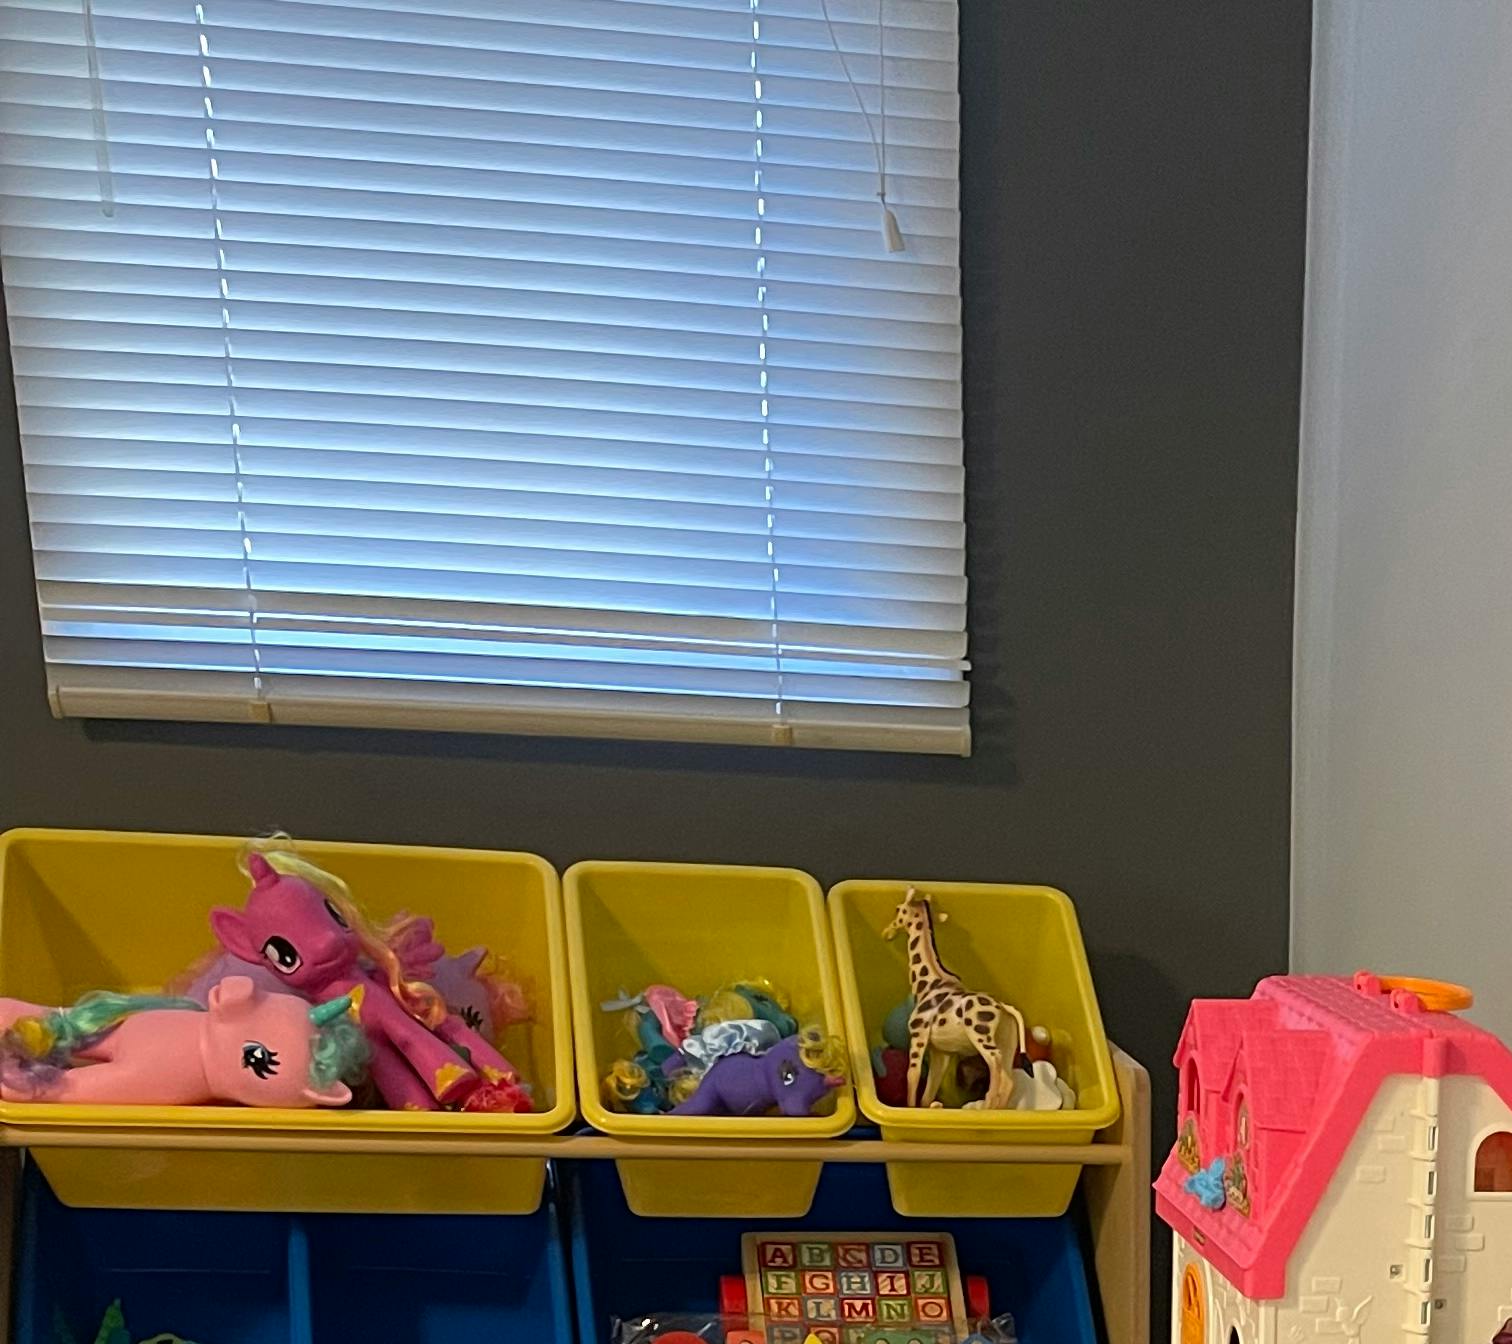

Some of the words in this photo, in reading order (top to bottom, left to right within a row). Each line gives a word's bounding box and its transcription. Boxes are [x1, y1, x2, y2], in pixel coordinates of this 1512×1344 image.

[767, 1246, 792, 1266] A
[879, 1246, 901, 1265] D
[918, 1246, 938, 1264] E
[773, 1274, 793, 1291] F
[808, 1274, 830, 1291] G
[847, 1275, 869, 1292] H
[886, 1275, 902, 1293] I
[920, 1274, 938, 1291] J
[776, 1301, 798, 1318] K
[812, 1302, 832, 1319] L
[846, 1302, 872, 1320] M
[883, 1302, 907, 1319] N
